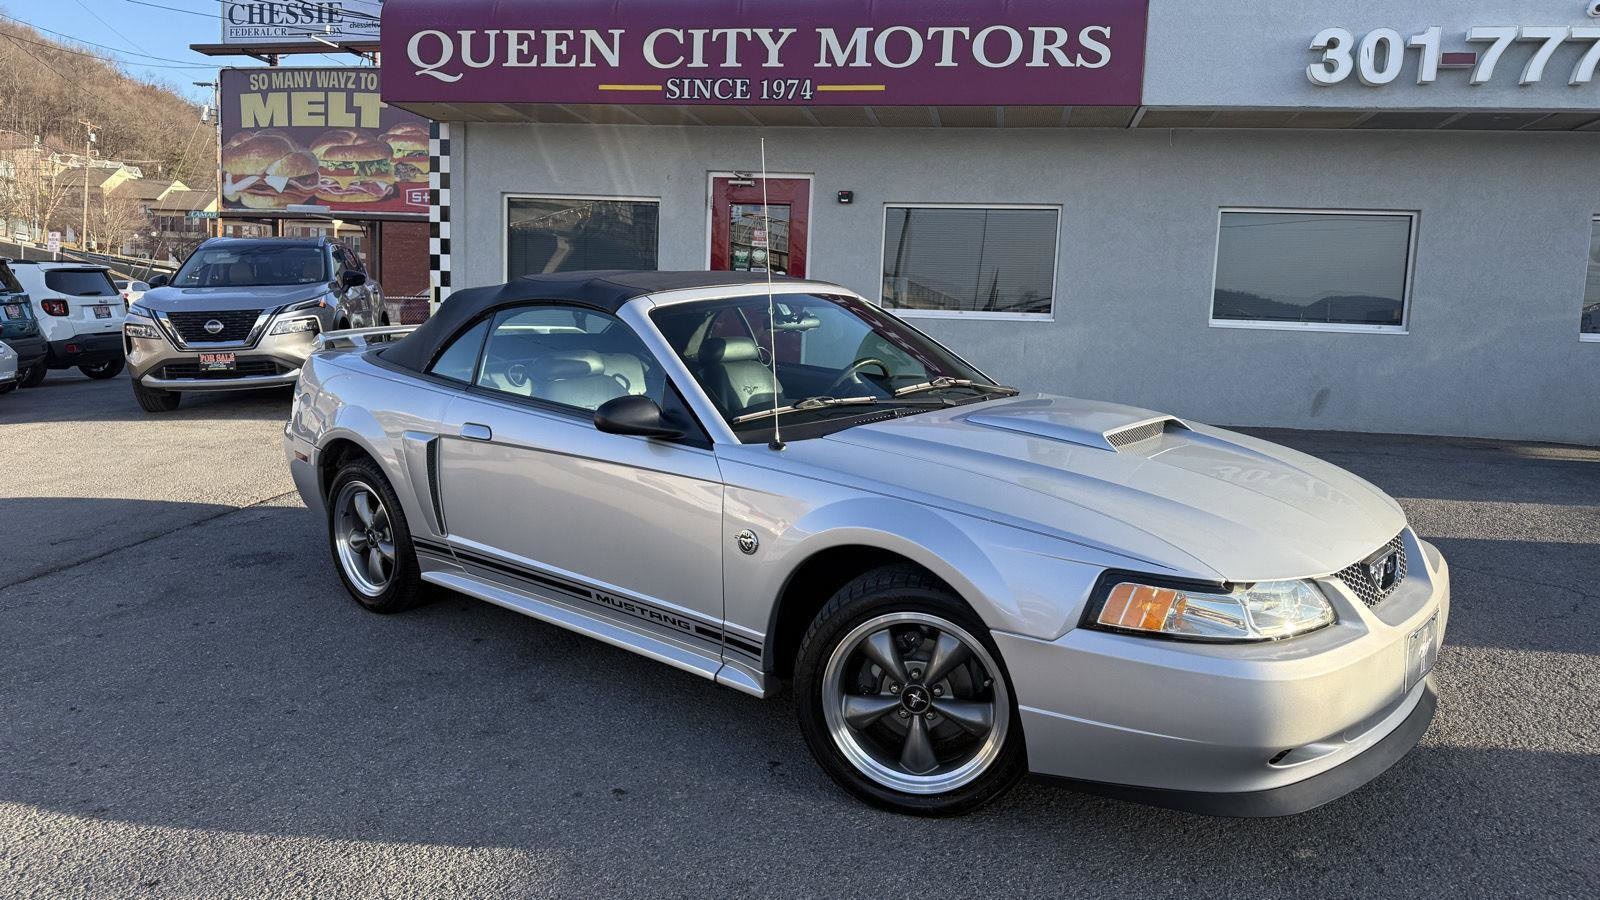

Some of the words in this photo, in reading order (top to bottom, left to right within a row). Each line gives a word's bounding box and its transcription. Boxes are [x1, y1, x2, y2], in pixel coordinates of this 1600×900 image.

[228, 2, 344, 25] CHESSIE
[229, 28, 272, 36] FEDERAL
[407, 29, 625, 83] QUEEN
[643, 28, 797, 69] CITY
[814, 25, 1112, 69] MOTORS
[249, 74, 269, 91] SO
[272, 71, 313, 90] MANY
[316, 71, 356, 89] WAYZ
[360, 72, 378, 91] TO
[665, 78, 751, 100] SINCE
[760, 79, 814, 100] 1974
[240, 91, 388, 129] MELT
[200, 354, 215, 362] FOR
[216, 352, 235, 362] SALE
[595, 593, 691, 630] MUSTANG
